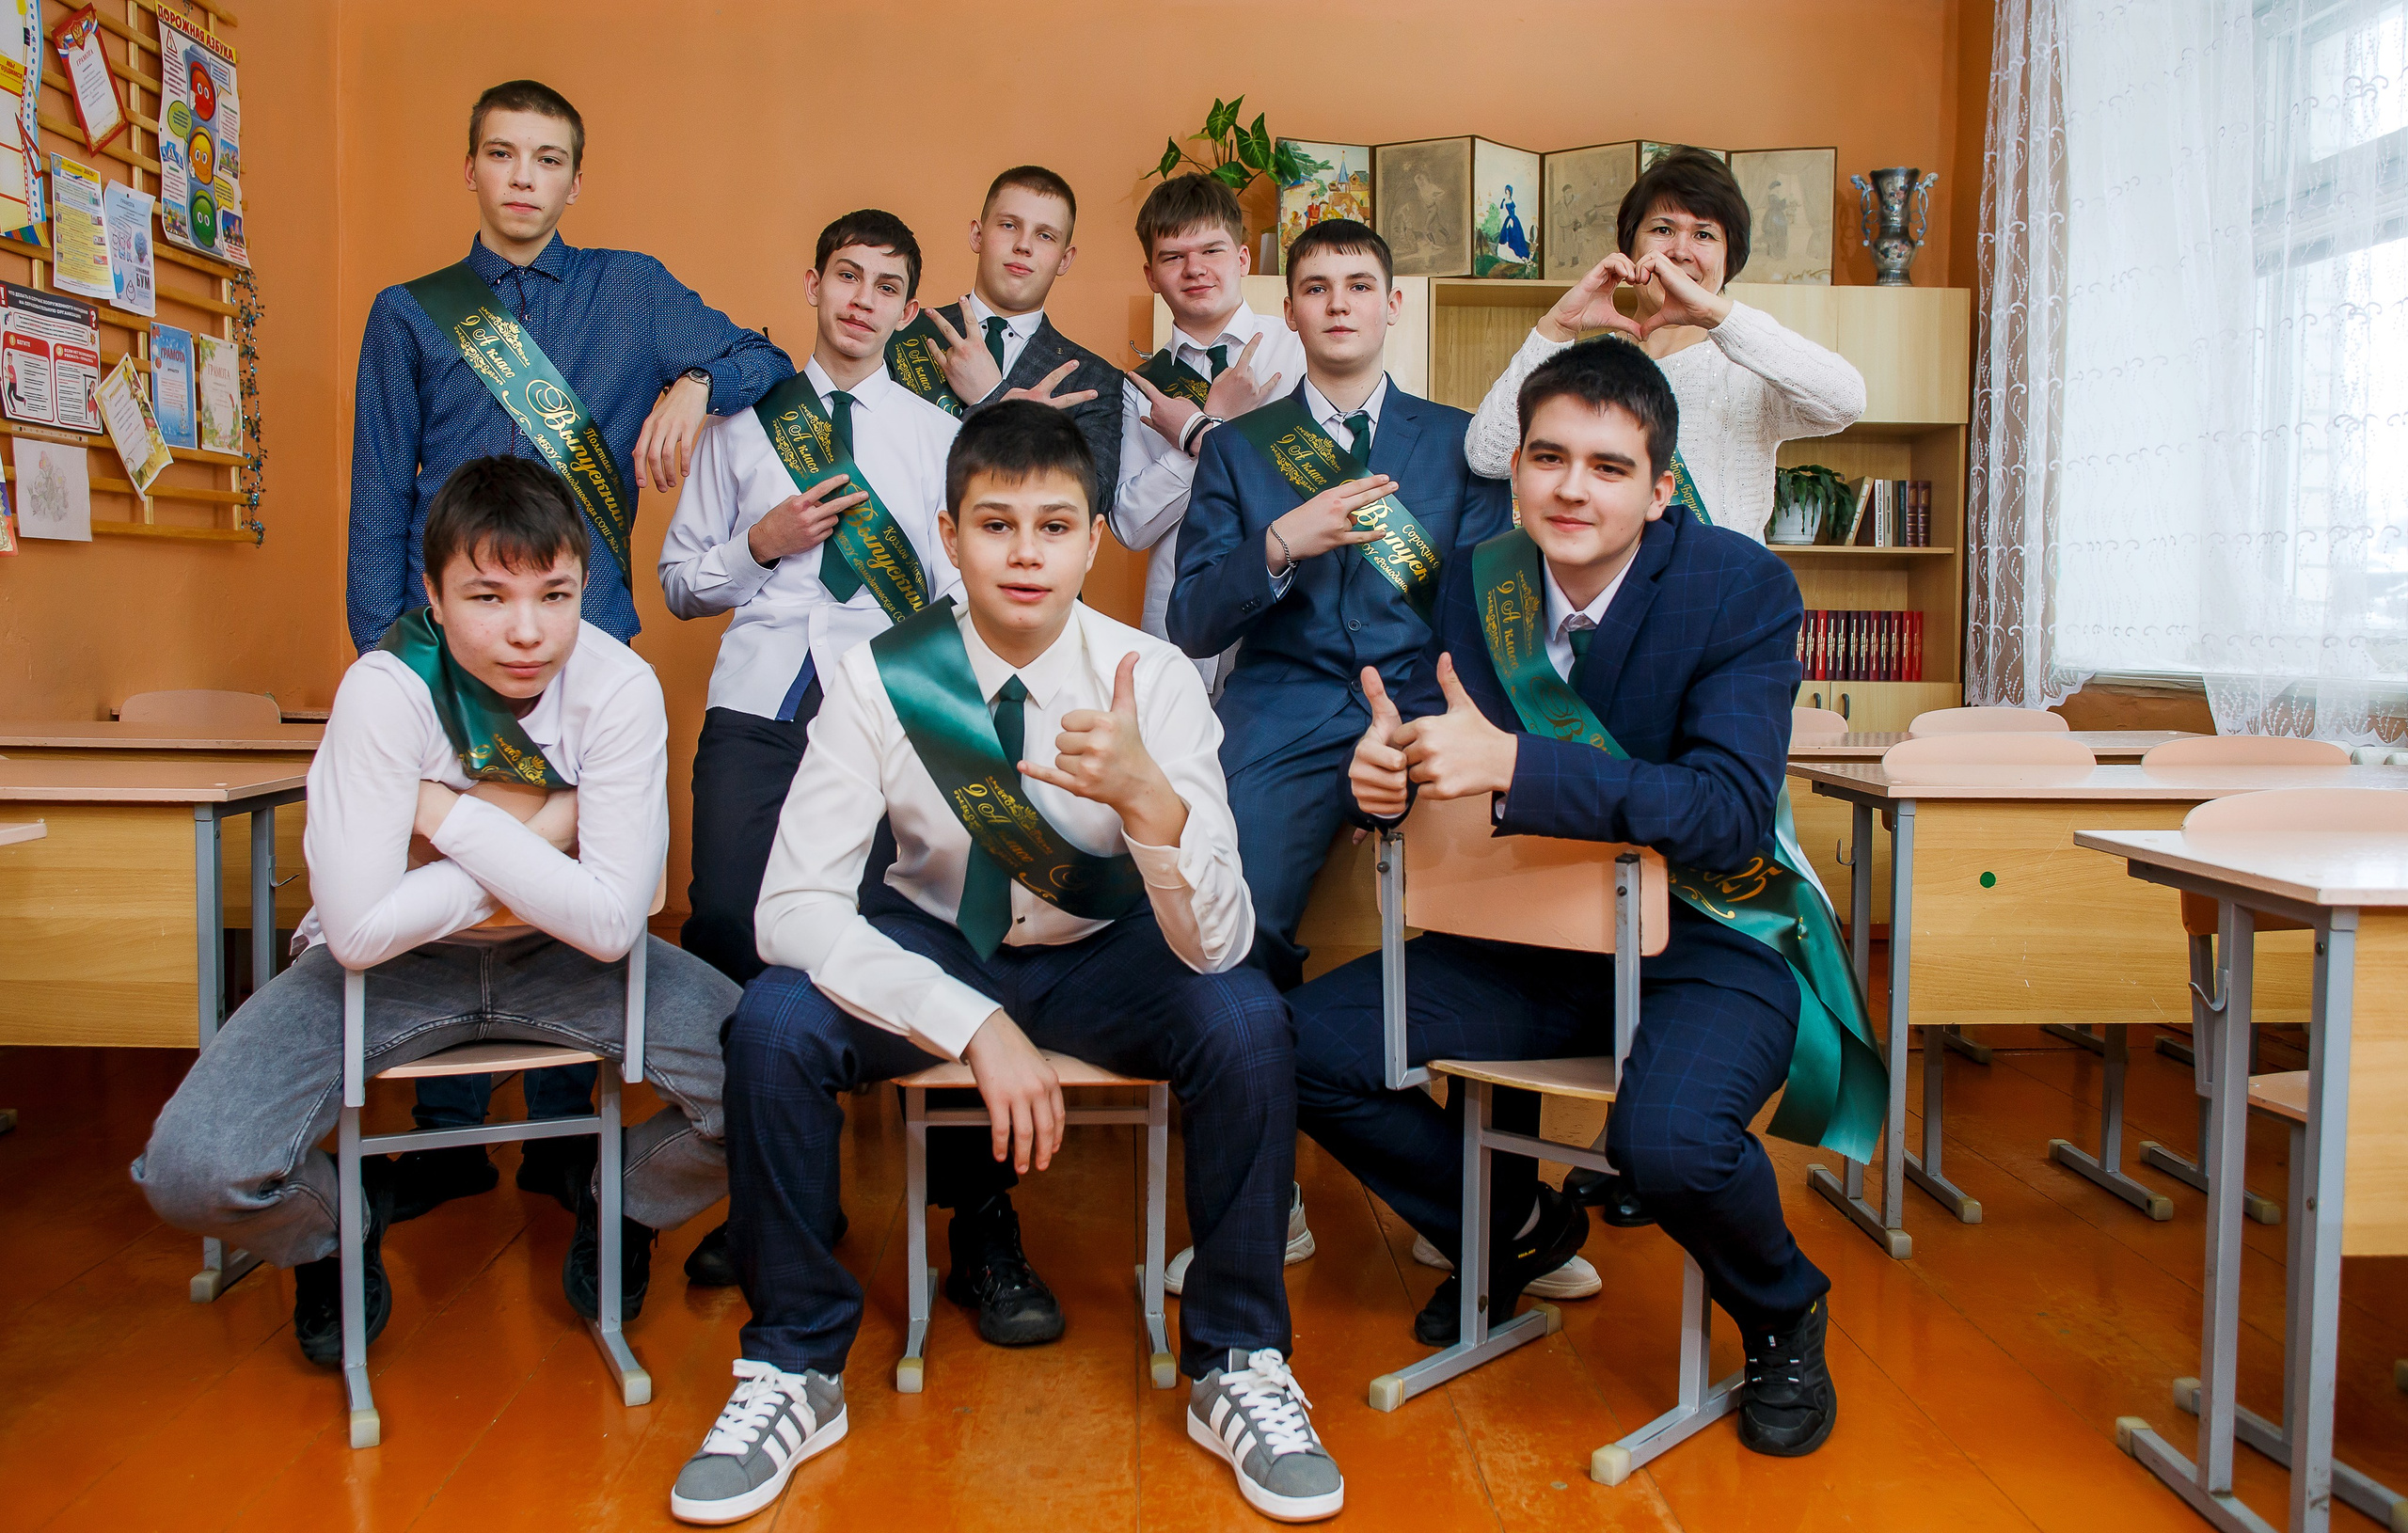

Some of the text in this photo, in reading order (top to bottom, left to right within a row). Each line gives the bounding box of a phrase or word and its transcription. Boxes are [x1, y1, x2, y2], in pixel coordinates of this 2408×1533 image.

[157, 4, 234, 62] ДОРОЖНАЯ АЗБУКА
[135, 273, 150, 291] БУМ
[160, 347, 186, 364] ГРАМОТА
[460, 314, 515, 378] 9 А класс
[902, 339, 932, 391] 9 А класс
[207, 363, 231, 381] ГРАМОТА
[525, 379, 626, 531] Выпускник
[582, 427, 613, 475] Полетаев
[779, 410, 820, 474] 9 А класс
[1276, 434, 1327, 485] 9 А класс
[533, 433, 562, 460] МБОУ
[594, 515, 610, 537] СОШ
[836, 481, 925, 613] Выпускни
[882, 525, 909, 561] Козлов
[1402, 524, 1436, 564] Сорокин
[1497, 579, 1522, 670] 9 А класс
[962, 783, 988, 798] 9
[977, 802, 1012, 824] А
